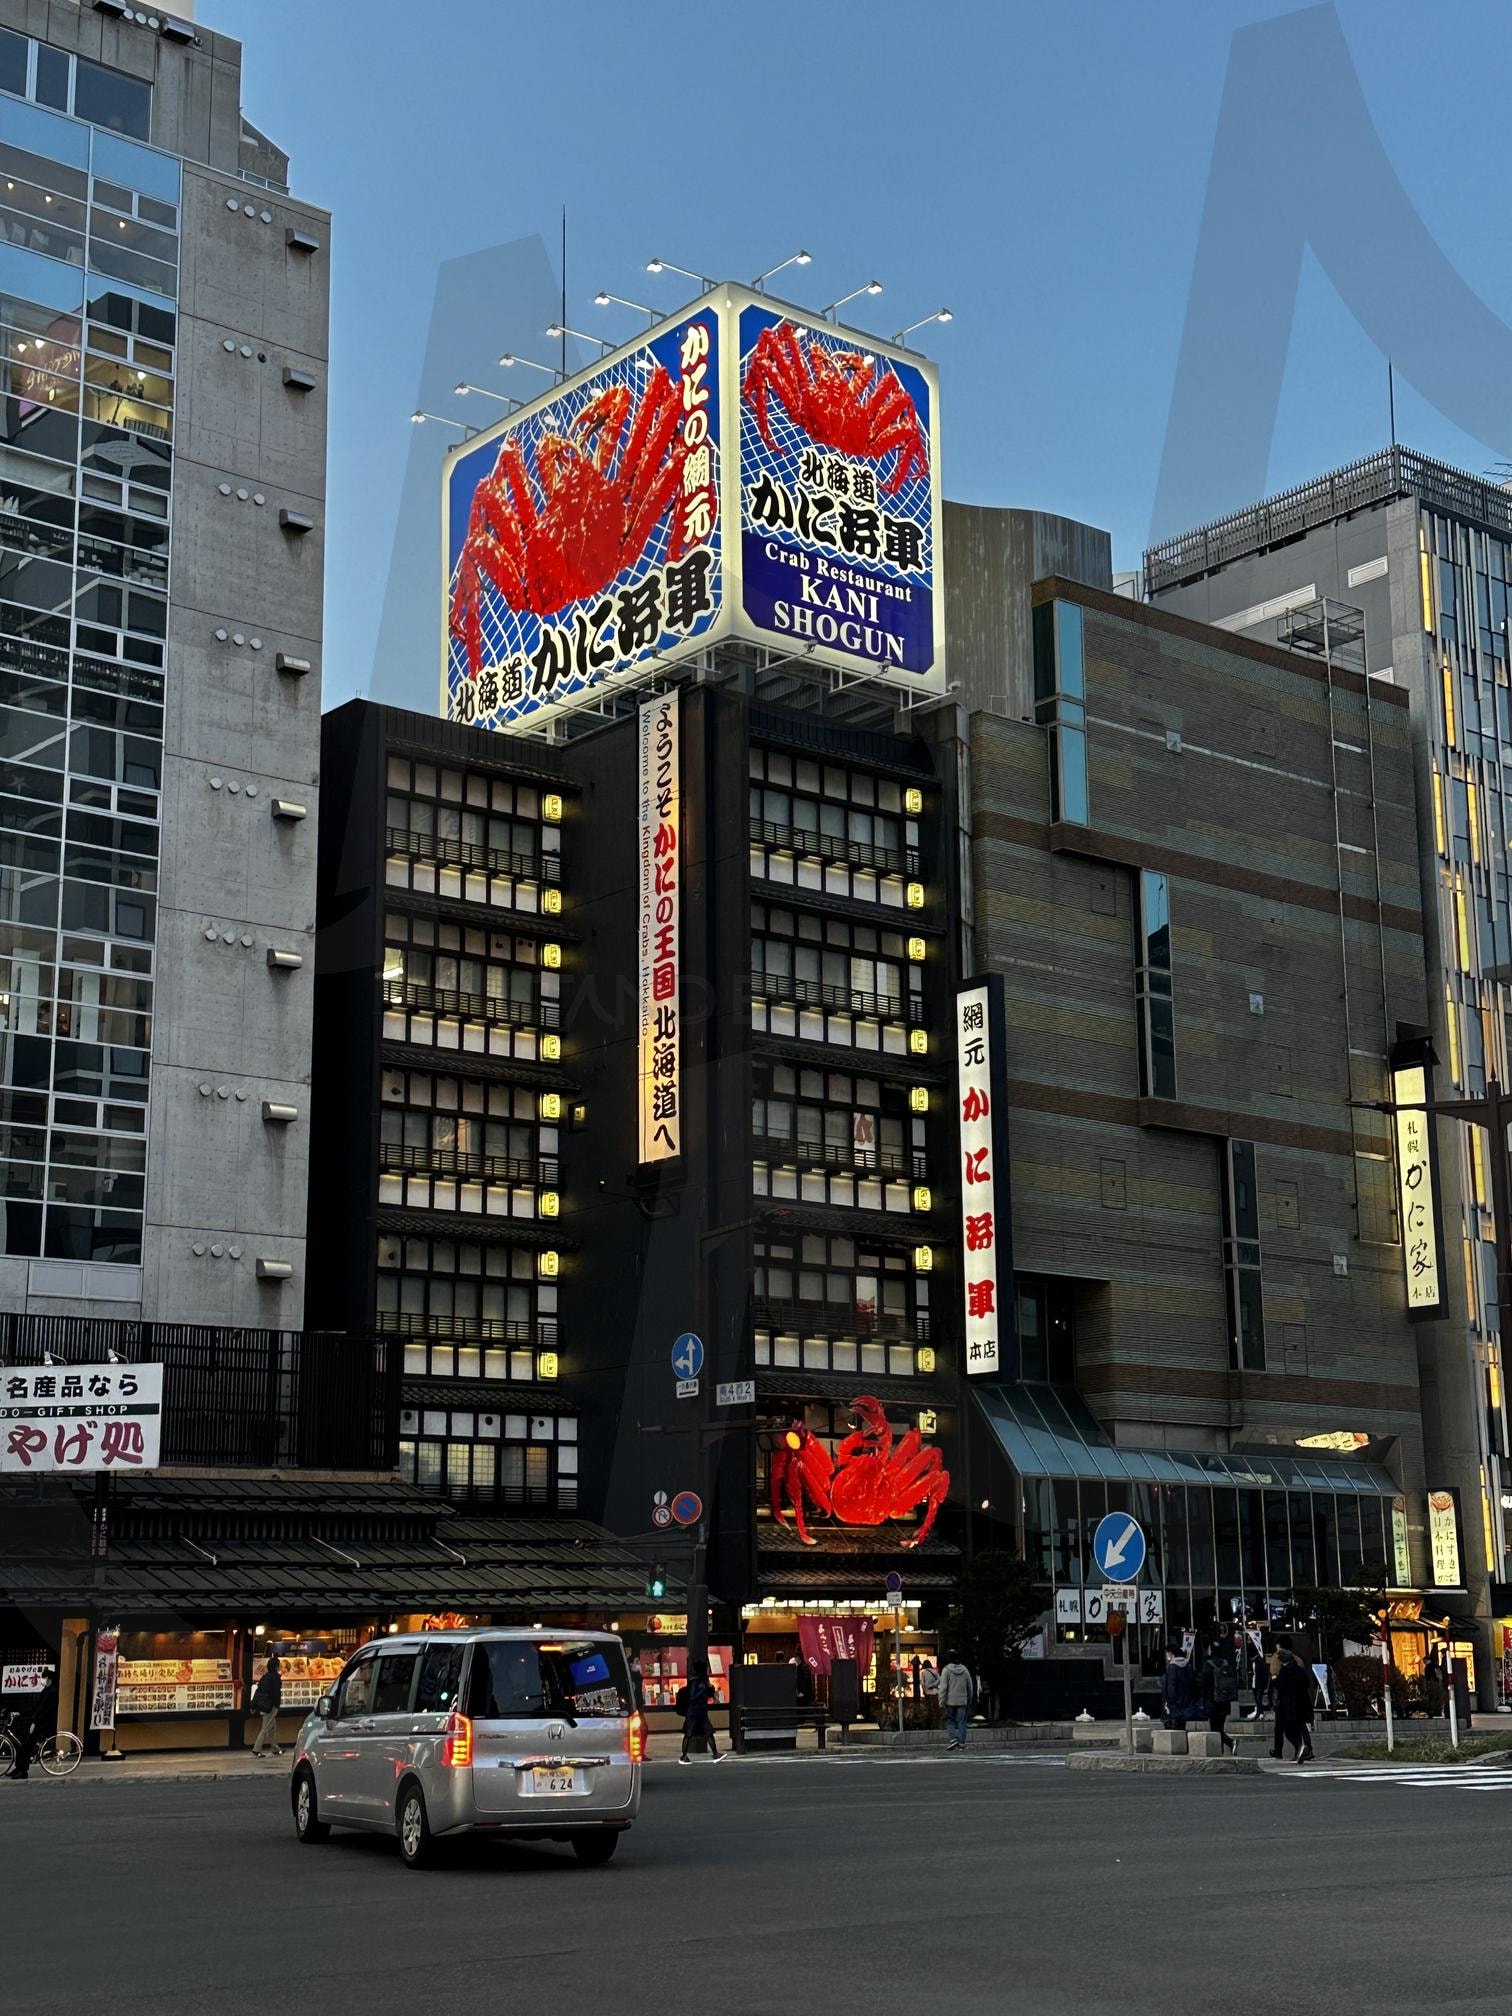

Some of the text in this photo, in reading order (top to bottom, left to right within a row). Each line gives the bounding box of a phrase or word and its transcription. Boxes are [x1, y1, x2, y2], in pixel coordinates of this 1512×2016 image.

[680, 325, 711, 544] かにの網元
[800, 450, 877, 505] 北海道
[750, 472, 925, 572] かに将軍
[764, 541, 913, 604] Crab Restaurant
[800, 572, 880, 625] KANI
[454, 550, 712, 724] 北海道 かに将軍
[773, 599, 906, 665] SHOGUN
[641, 780, 650, 795] to
[641, 797, 650, 822] the
[641, 894, 651, 910] of
[962, 1002, 997, 1361] 網元 かに将軍 本店
[0, 1374, 139, 1399] 名産品なら
[84, 1405, 129, 1416] SHOP
[6, 1420, 145, 1467] やげ処
